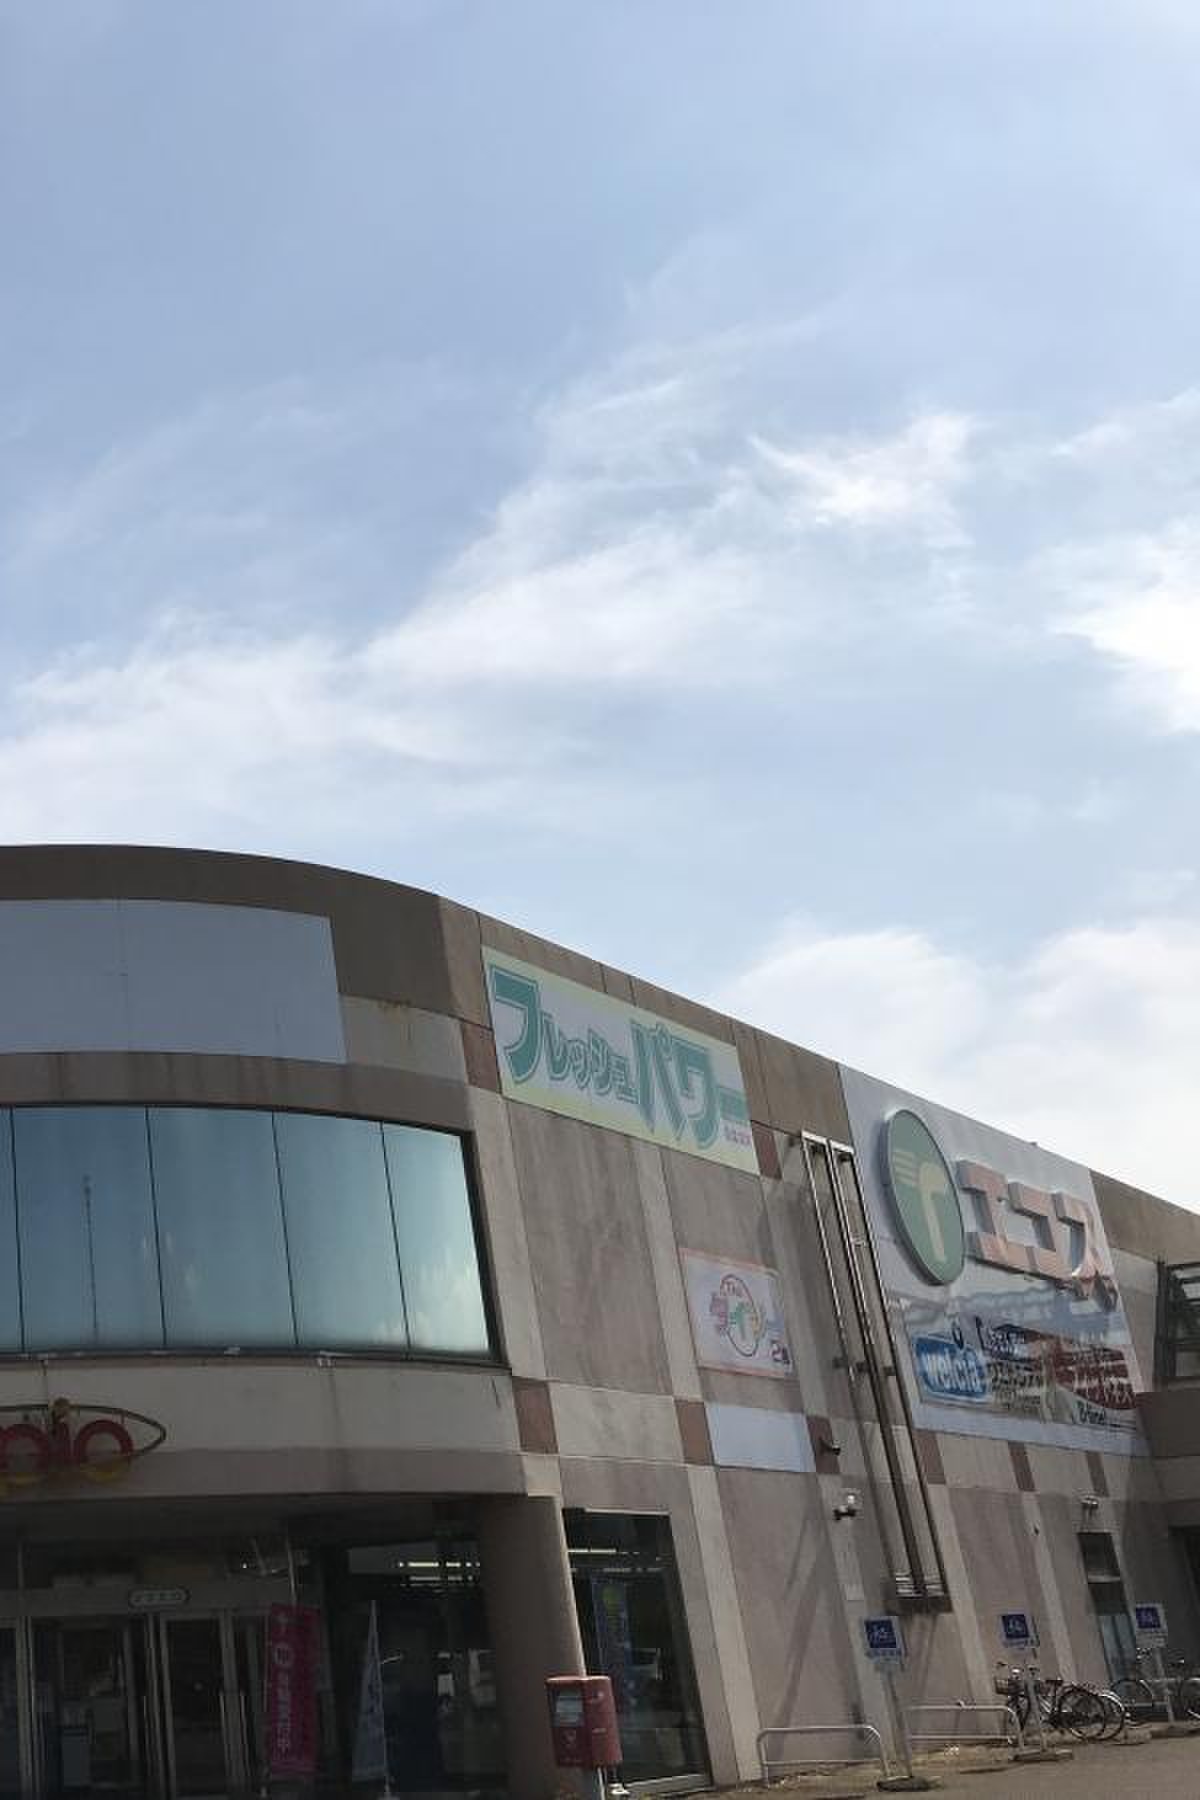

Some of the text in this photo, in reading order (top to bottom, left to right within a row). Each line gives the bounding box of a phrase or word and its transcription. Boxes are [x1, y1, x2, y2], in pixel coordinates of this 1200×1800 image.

[488, 964, 751, 1151] フレッシュパワー
